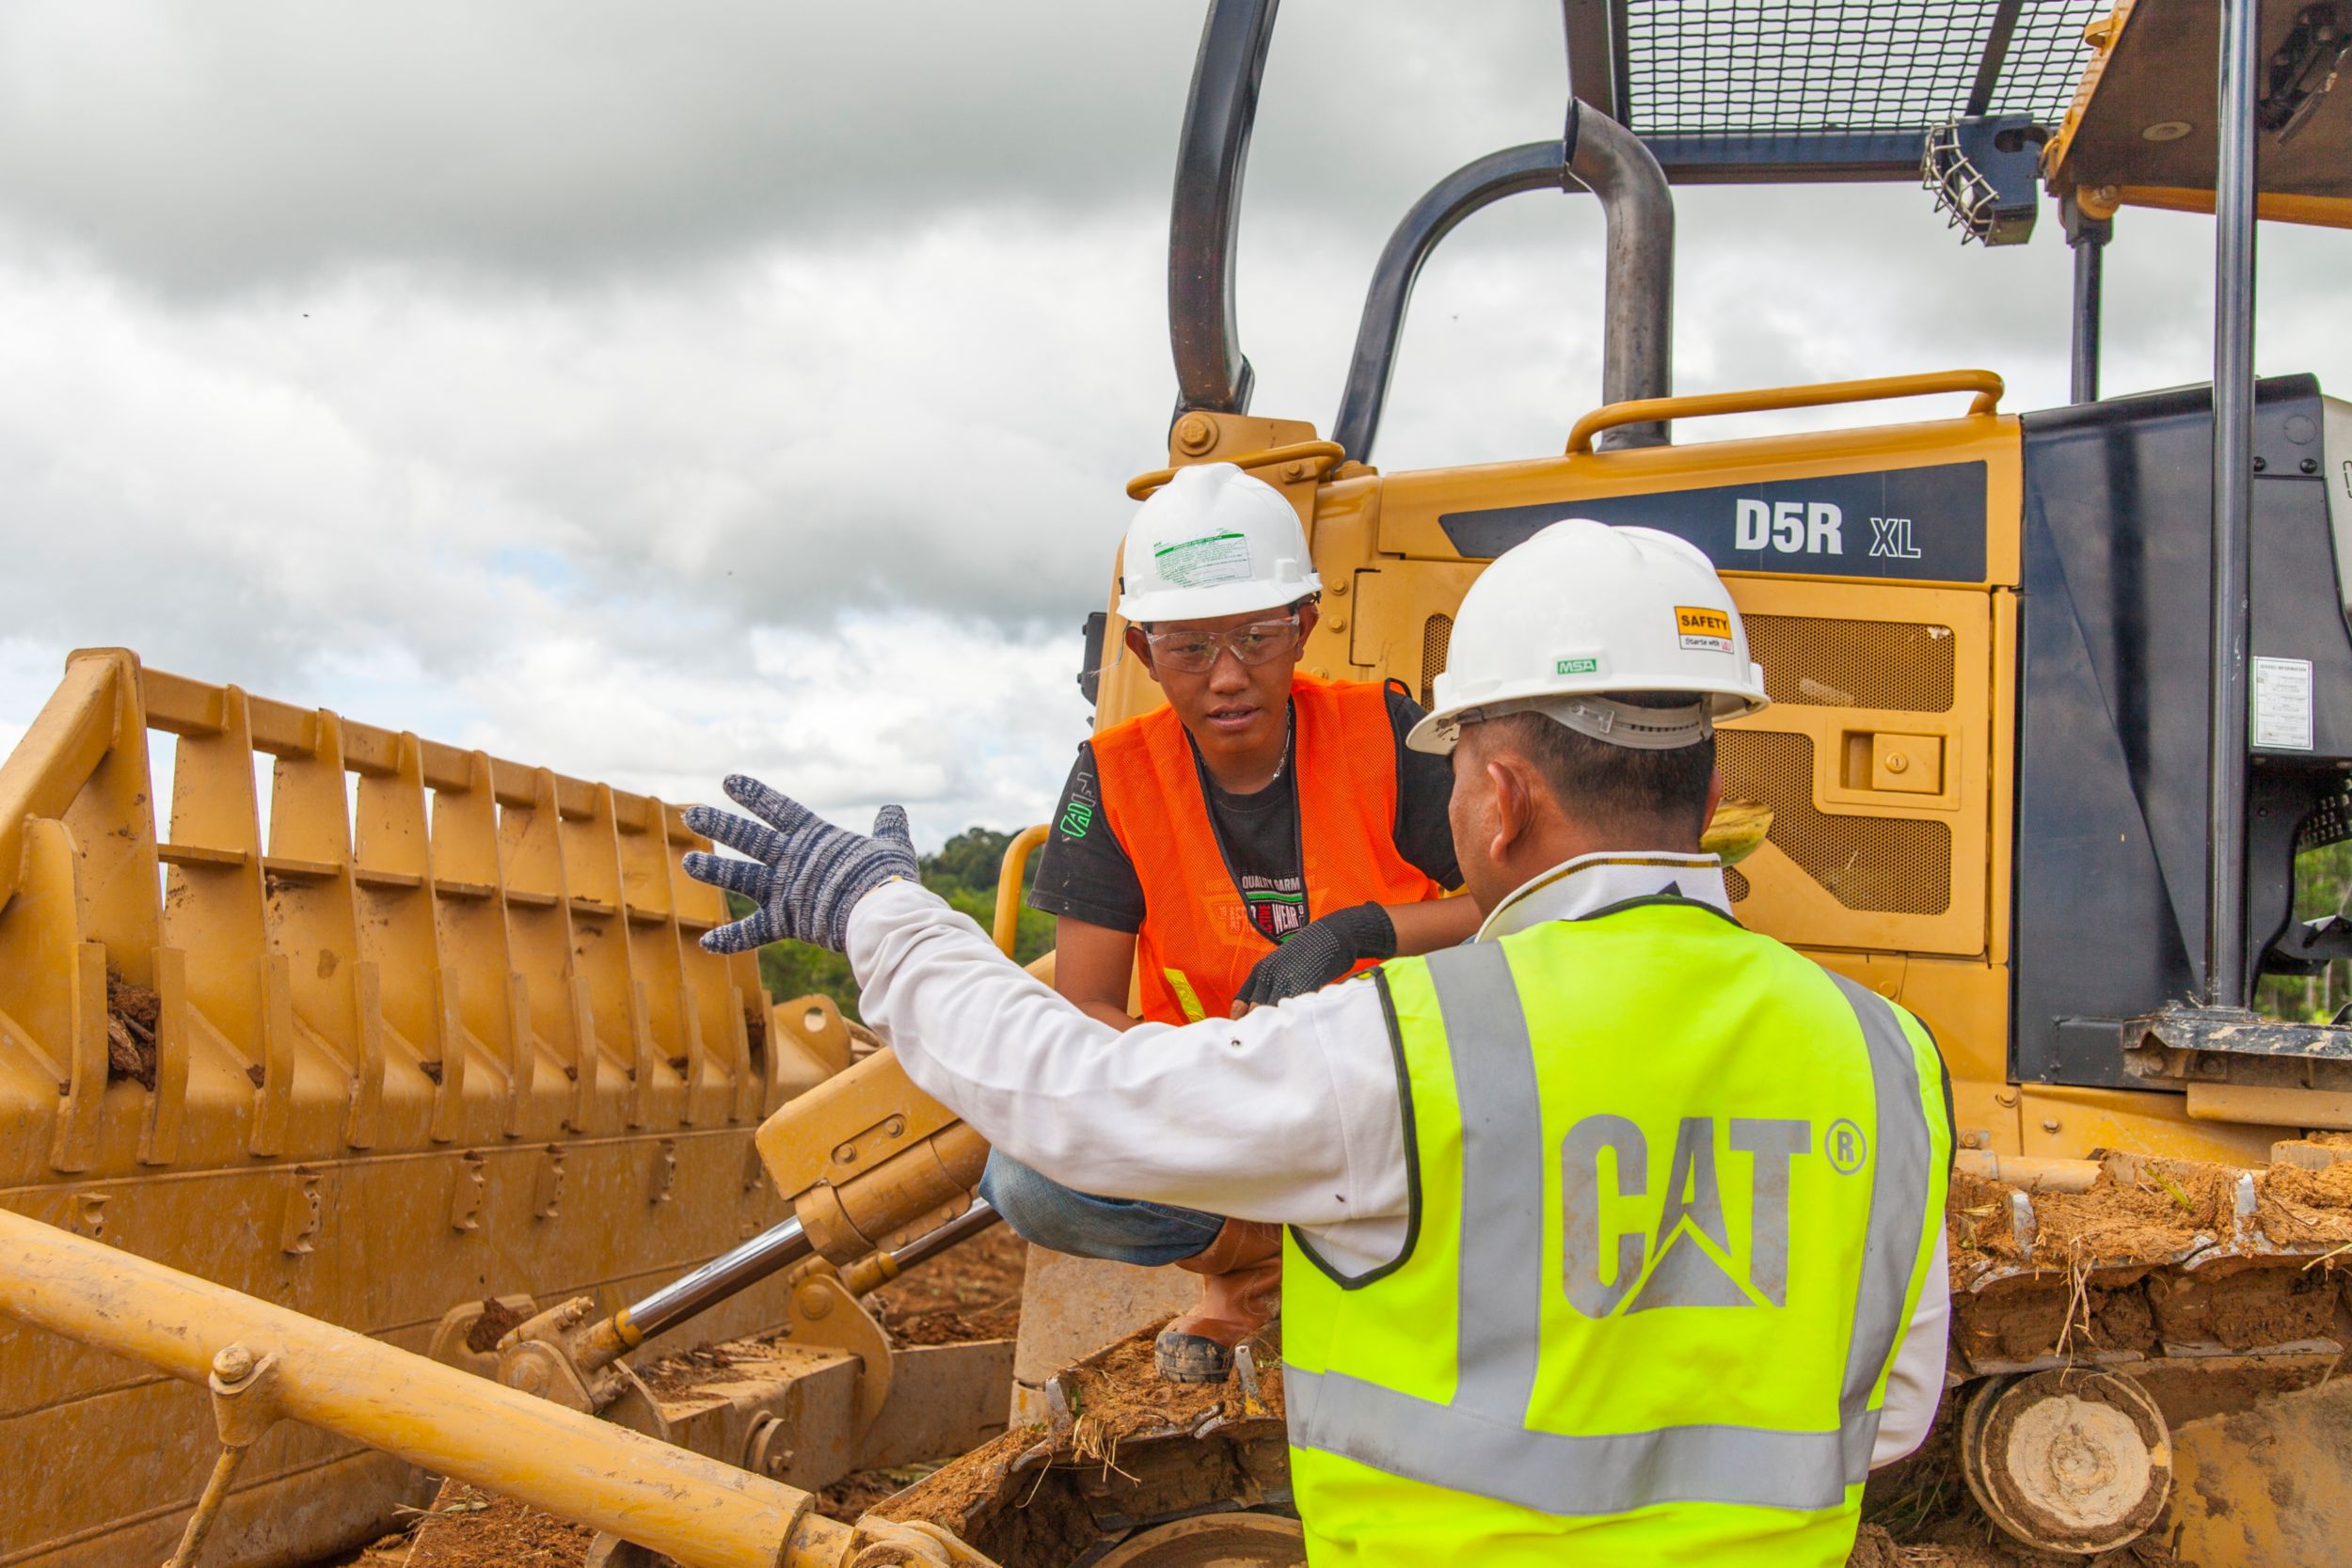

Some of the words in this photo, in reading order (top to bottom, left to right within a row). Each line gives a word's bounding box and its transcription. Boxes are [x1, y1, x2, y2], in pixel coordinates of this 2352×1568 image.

[1735, 499, 1843, 555] D5R
[1868, 517, 1921, 559] XL
[1681, 614, 1727, 630] SAFETY
[1559, 660, 1596, 673] MSA
[1242, 875, 1274, 889] QUALITY
[1272, 903, 1299, 934] WEAR
[1561, 1114, 1812, 1320] CAT
